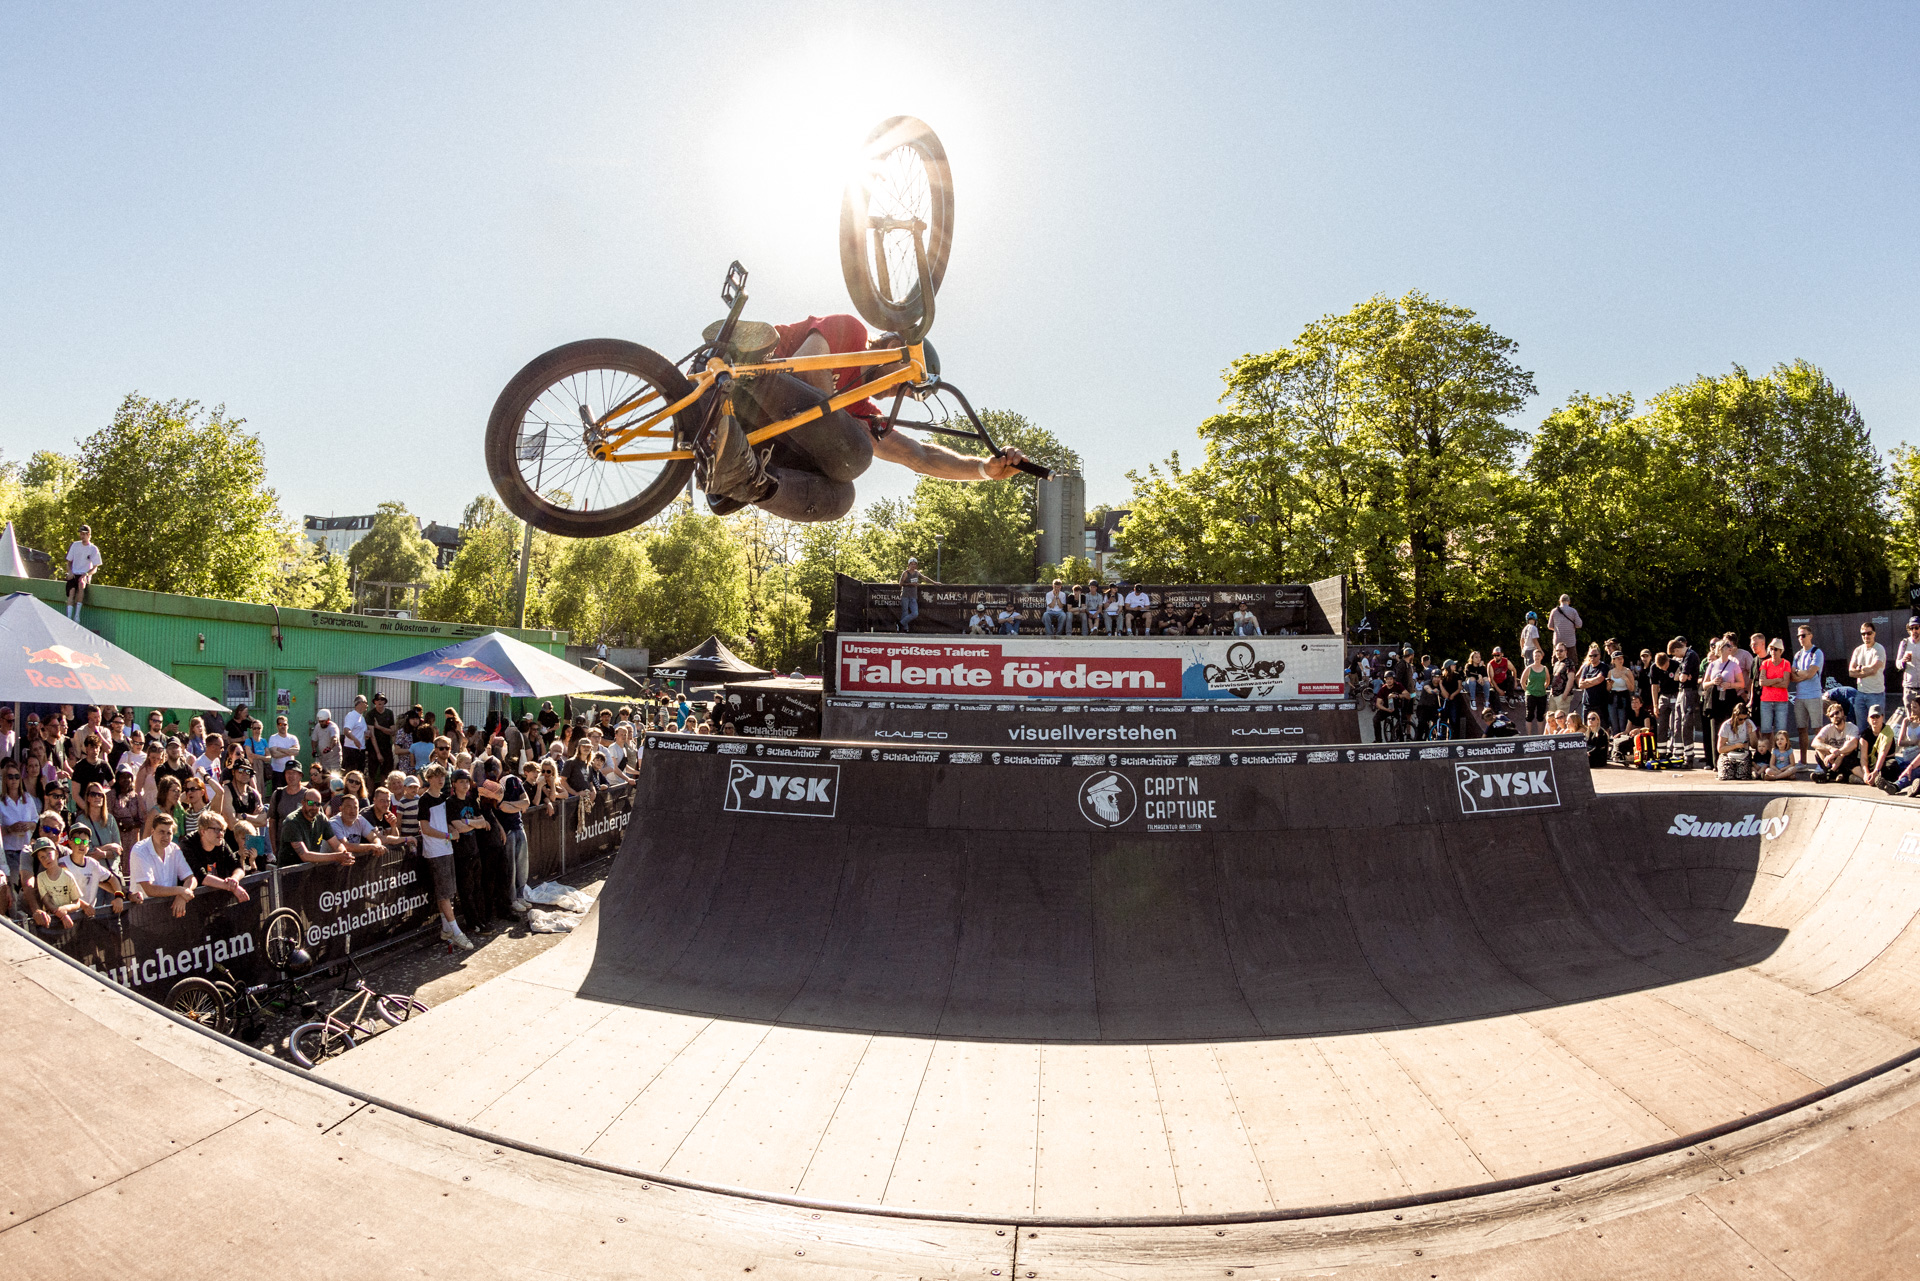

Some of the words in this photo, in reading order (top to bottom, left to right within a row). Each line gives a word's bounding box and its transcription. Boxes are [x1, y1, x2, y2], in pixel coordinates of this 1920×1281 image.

[844, 644, 884, 655] Unser
[887, 646, 941, 657] größtes
[944, 647, 989, 657] Talent:
[24, 669, 83, 689] Red
[80, 673, 132, 692] Bull
[419, 667, 455, 677] Red
[843, 658, 992, 685] Talente
[1001, 662, 1165, 689] fördern.
[1008, 725, 1177, 740] visuellverstehen
[749, 774, 832, 802] JYSK
[1144, 776, 1198, 796] CAPT'N
[1480, 770, 1552, 798] JYSK
[1145, 800, 1217, 819] CAPTURE
[1667, 813, 1789, 840] Sunday
[319, 870, 417, 912] @sportpiraten
[307, 893, 429, 946] @schlachthofbmx
